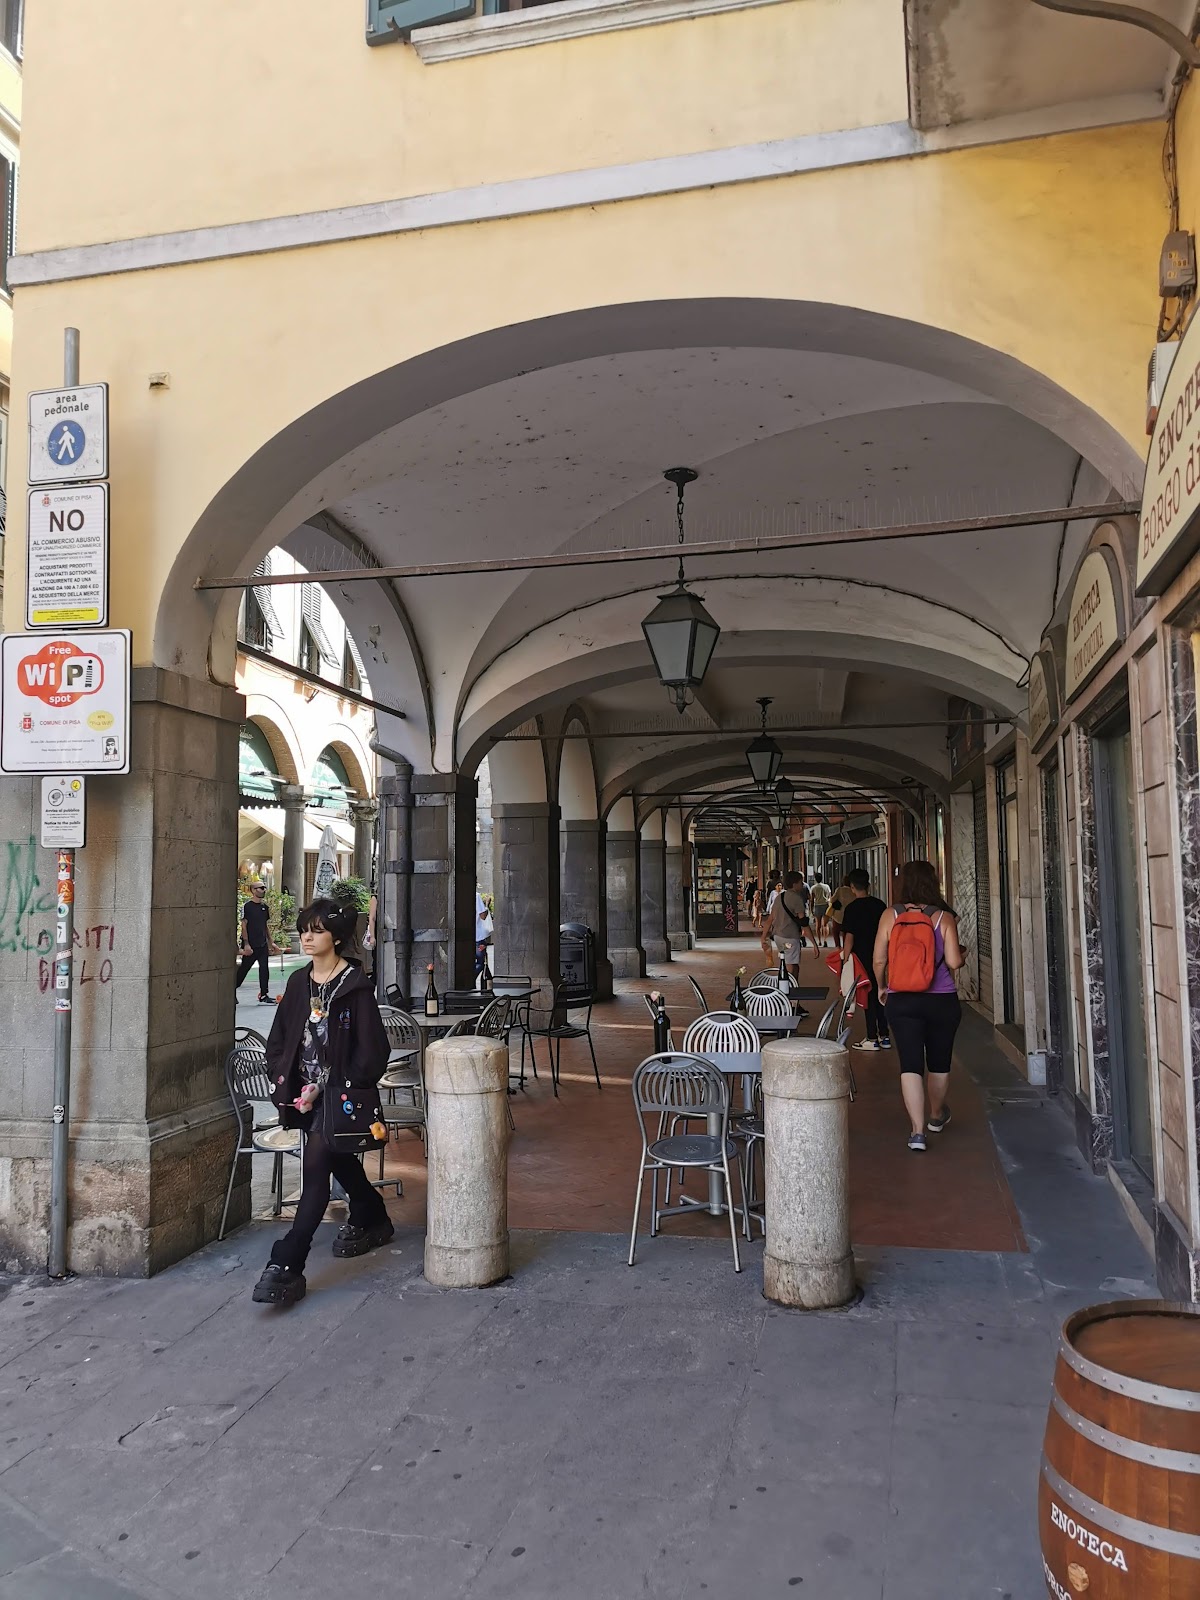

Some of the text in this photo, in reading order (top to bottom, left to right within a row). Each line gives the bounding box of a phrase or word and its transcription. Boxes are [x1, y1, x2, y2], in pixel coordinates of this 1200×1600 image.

[56, 394, 77, 404] area
[44, 402, 90, 417] pedonale
[49, 509, 85, 532] NO
[1142, 467, 1181, 560] BORGO
[1072, 579, 1101, 643] ENOTECA
[49, 646, 72, 655] Free
[49, 694, 72, 704] spot
[1050, 1502, 1129, 1573] ENOTECA
